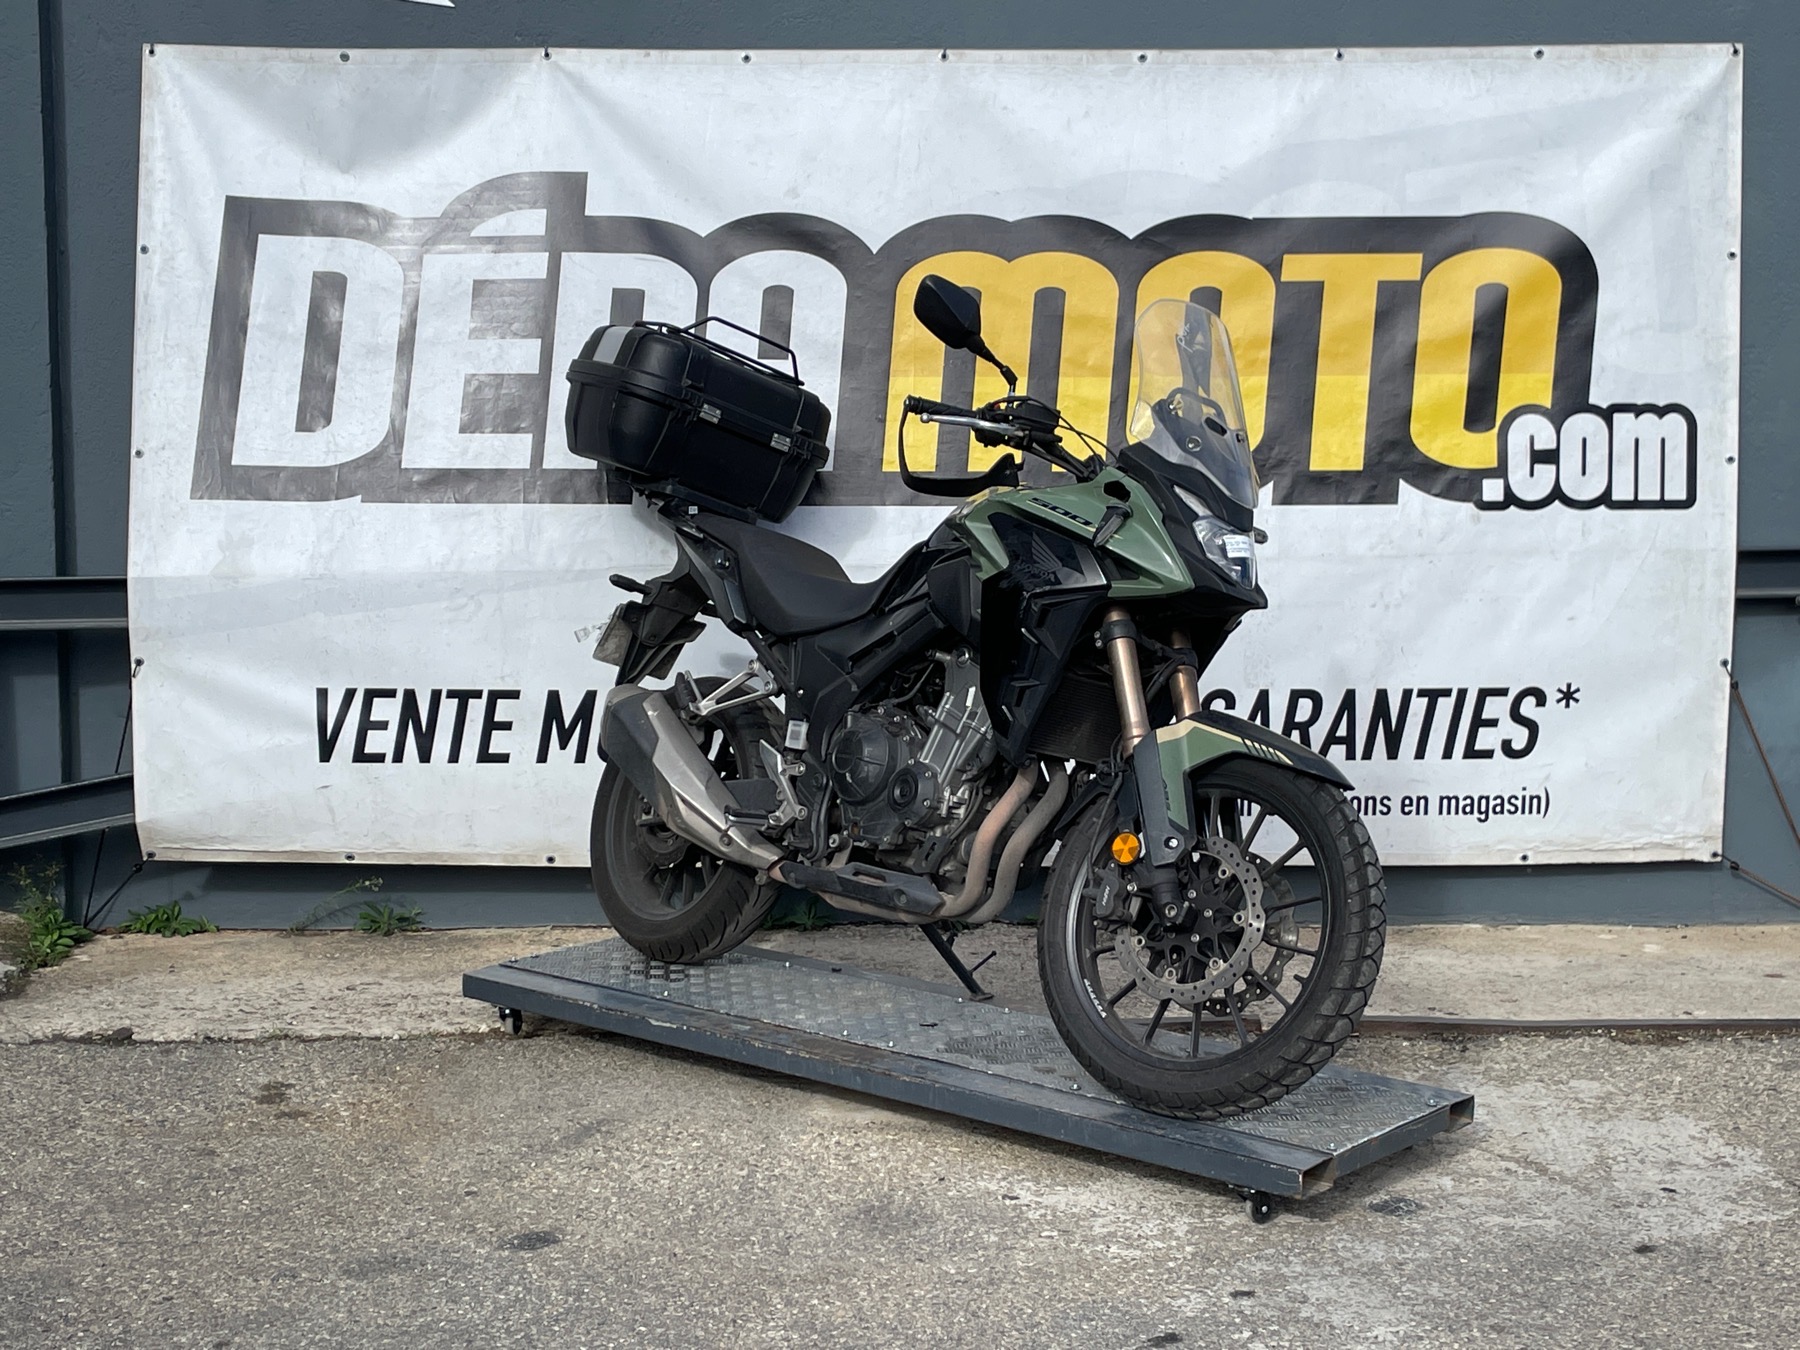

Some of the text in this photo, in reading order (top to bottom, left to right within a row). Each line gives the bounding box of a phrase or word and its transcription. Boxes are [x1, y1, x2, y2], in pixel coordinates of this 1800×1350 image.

[1481, 411, 1688, 502] .com
[1029, 497, 1093, 526] 500
[314, 687, 521, 764] VENTE
[1400, 794, 1429, 816] en
[1438, 786, 1551, 824] magasin)
